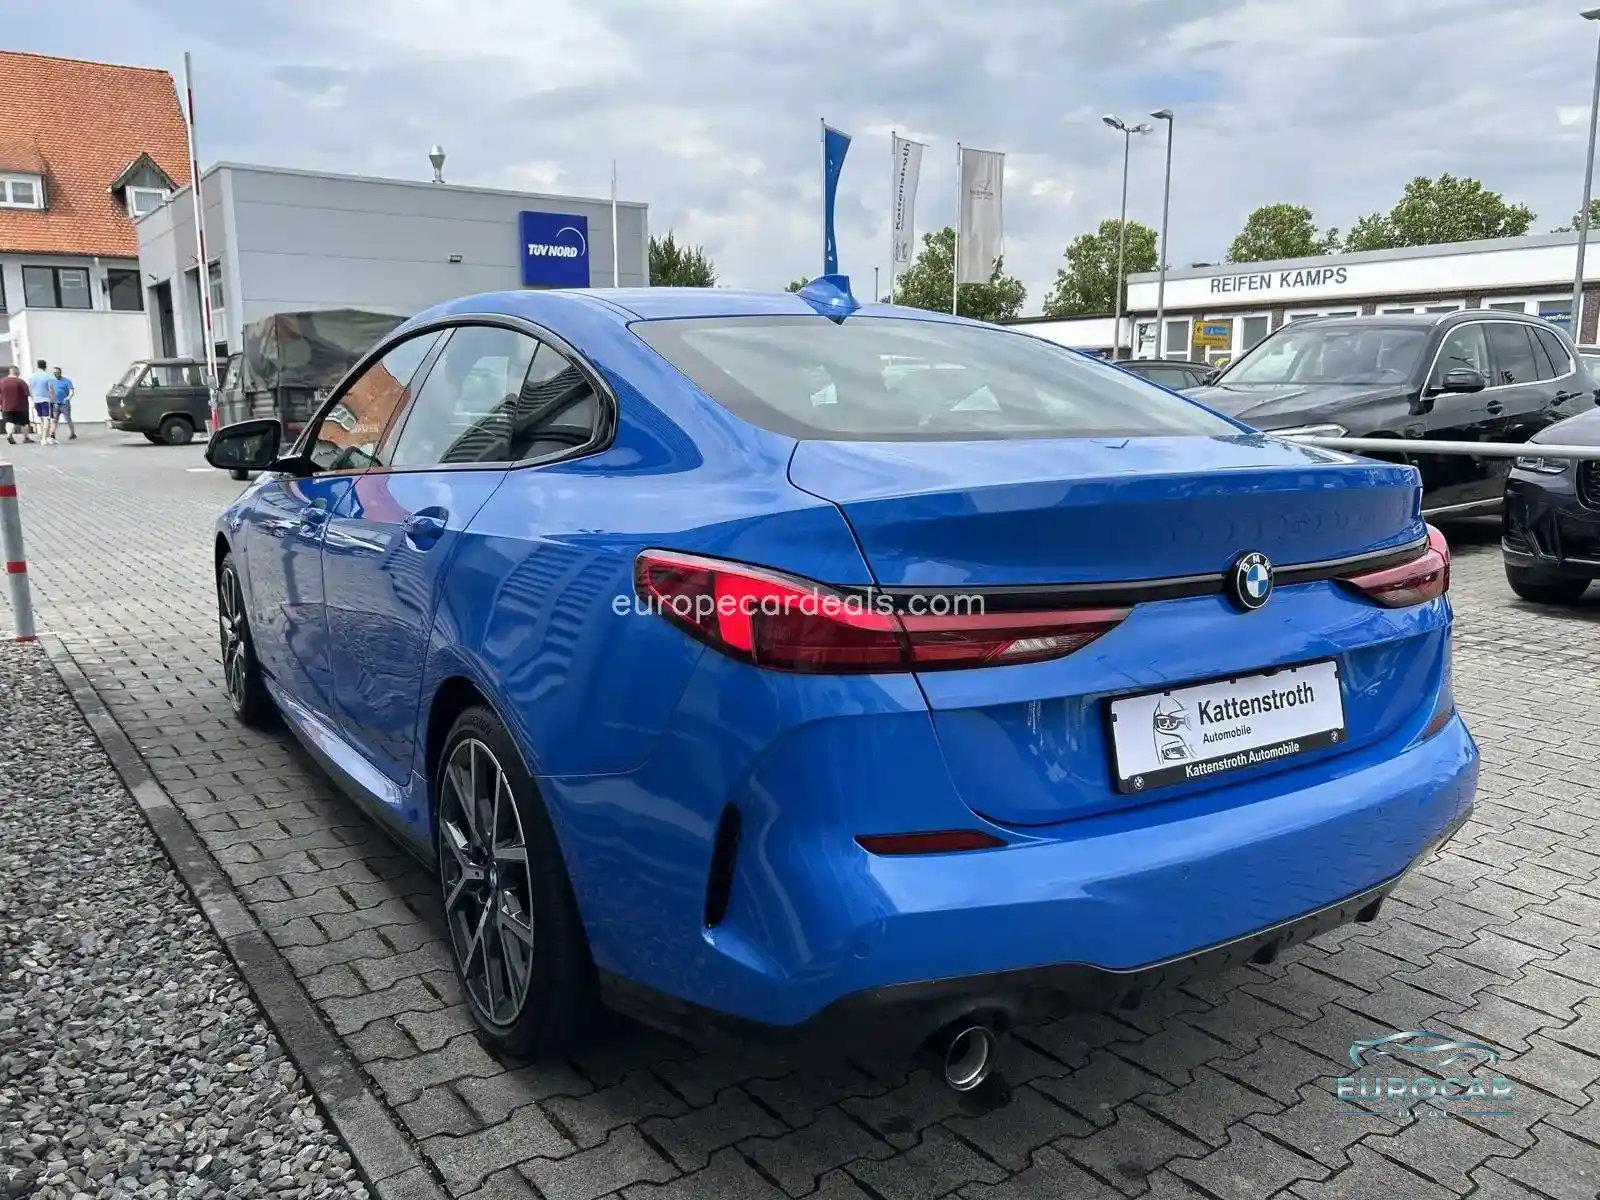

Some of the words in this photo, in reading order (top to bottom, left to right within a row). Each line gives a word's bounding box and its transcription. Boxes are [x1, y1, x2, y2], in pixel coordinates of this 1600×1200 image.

[895, 143, 911, 230] Kattenstroth
[548, 245, 578, 258] NORD
[1211, 273, 1272, 293] REIFEN
[1280, 267, 1348, 288] KAMPS
[1240, 554, 1272, 573] BMW
[1198, 681, 1315, 726] Kattenstroth
[1203, 725, 1252, 744] Automobile
[1185, 752, 1248, 778] Kattenstroth
[1249, 742, 1300, 765] Automobile
